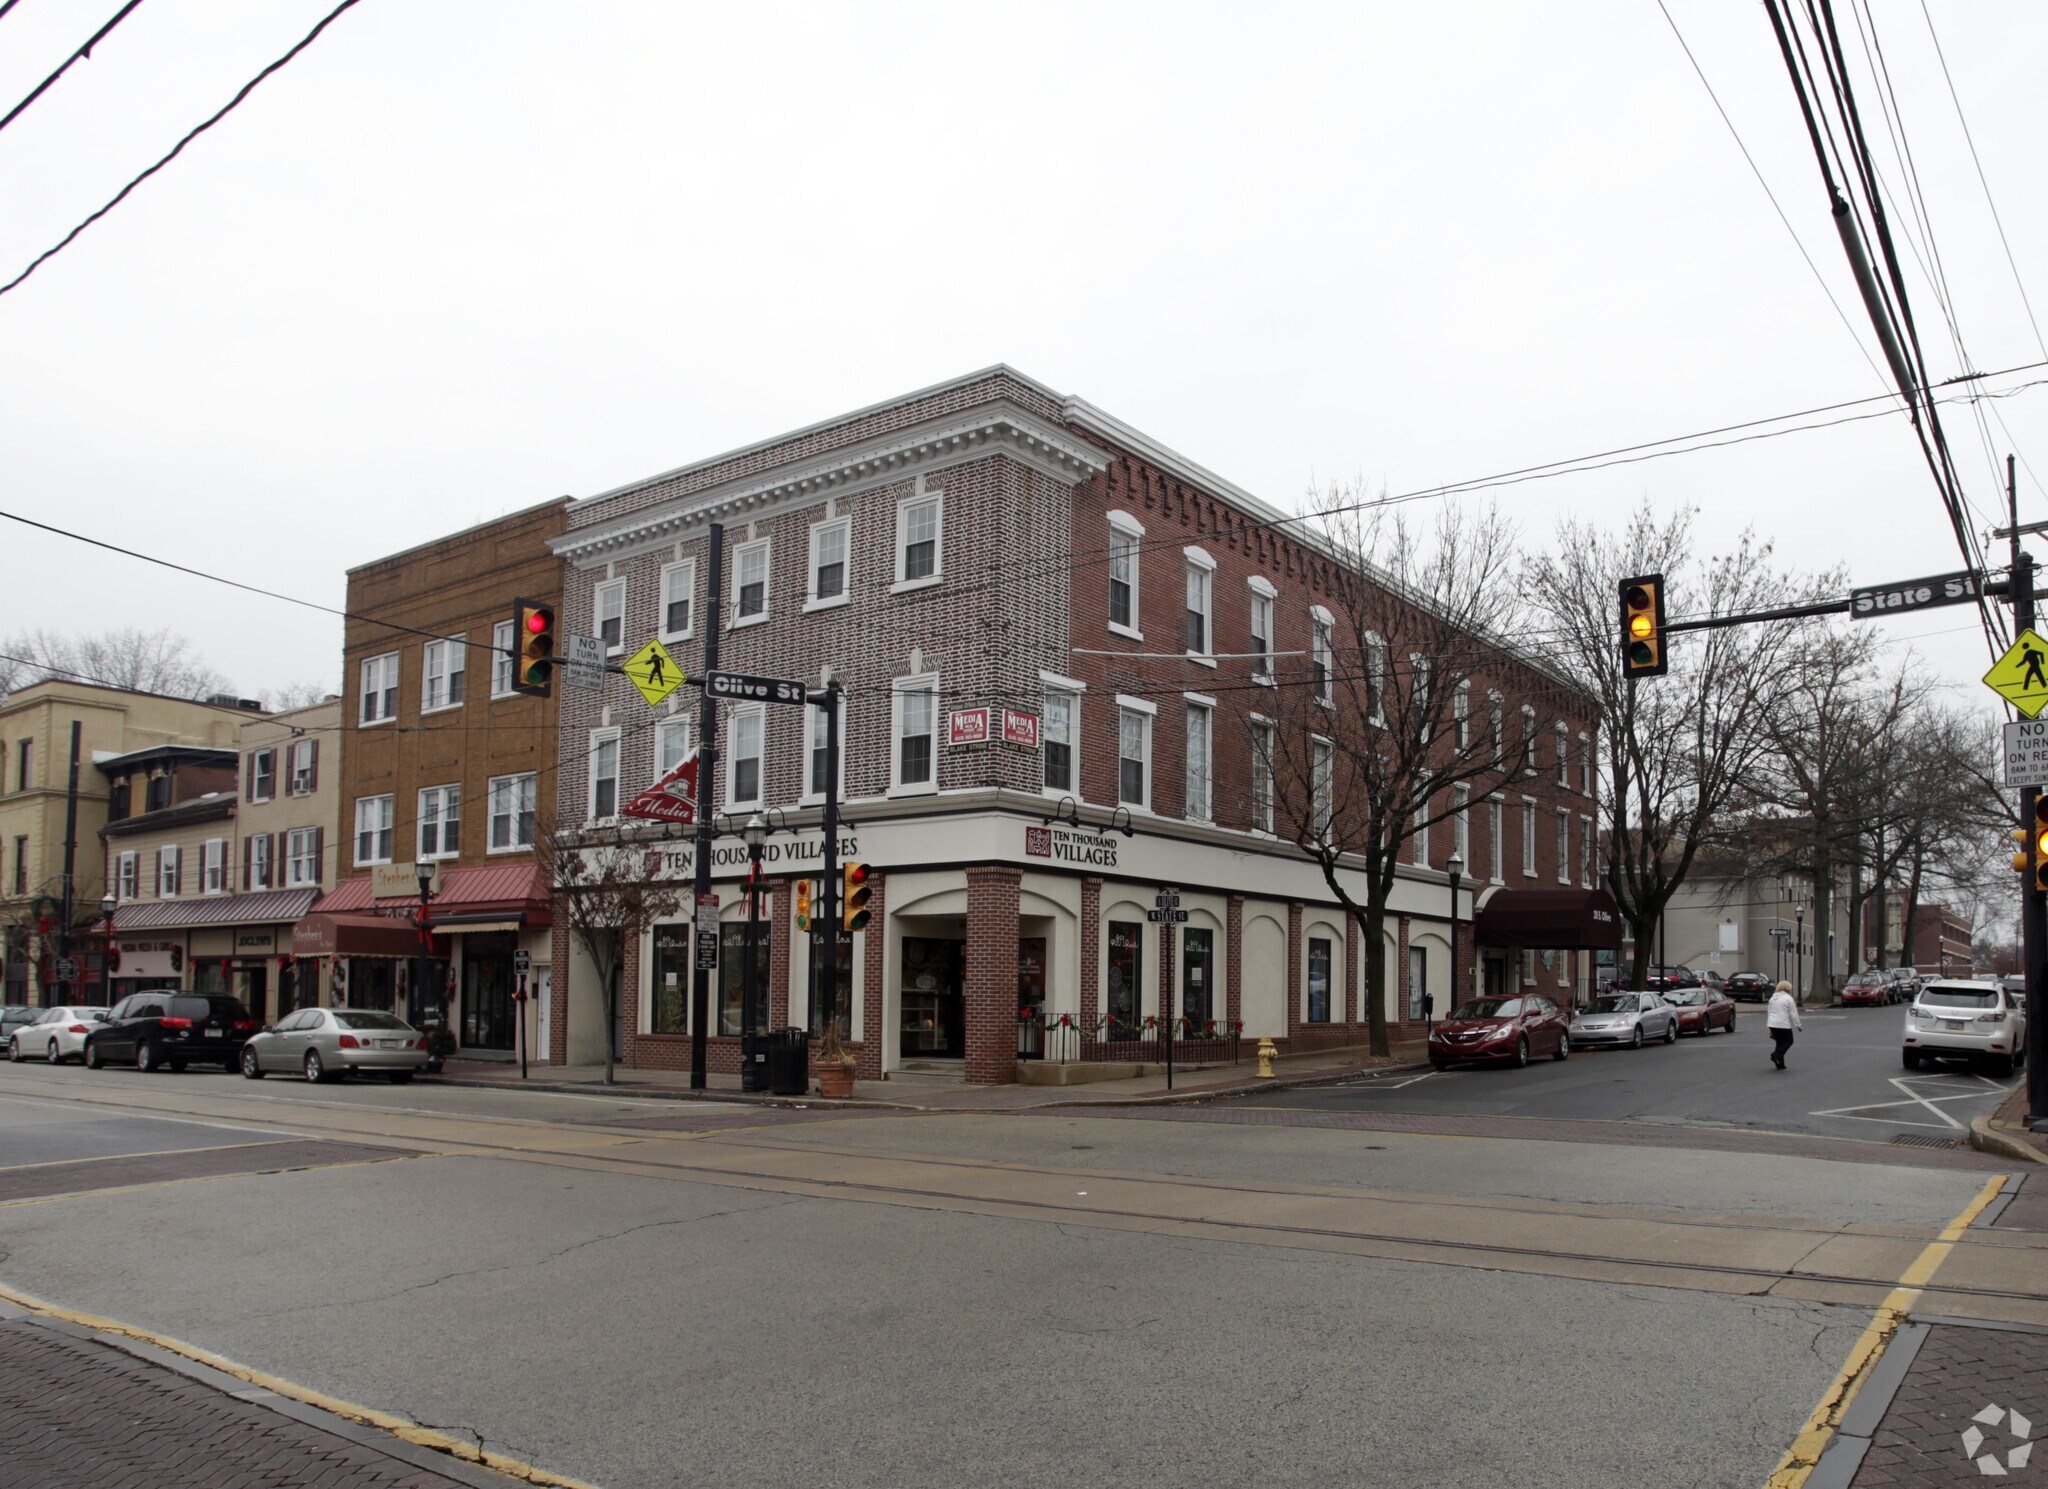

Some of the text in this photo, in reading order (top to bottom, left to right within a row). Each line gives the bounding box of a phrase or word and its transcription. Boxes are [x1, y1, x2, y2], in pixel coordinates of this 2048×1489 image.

[1856, 577, 1976, 611] State St
[579, 638, 596, 650] NO
[576, 649, 599, 661] TURN
[570, 658, 602, 671] ON RED
[714, 676, 800, 700] Olive St
[954, 713, 984, 731] MEDIA
[1007, 714, 1034, 734] MEDIA
[2020, 723, 2045, 737] NO
[950, 745, 968, 753] BLAKE
[2016, 738, 2048, 750] TURN
[2009, 752, 2026, 764] ON
[2010, 765, 2026, 774] 8AM
[2029, 764, 2038, 772] TO
[2009, 775, 2031, 785] EXCEPT
[629, 798, 690, 818] Media
[1053, 830, 1117, 849] TEN THOUSAND
[665, 851, 692, 869] TEN
[1053, 842, 1117, 867] VILLAGES
